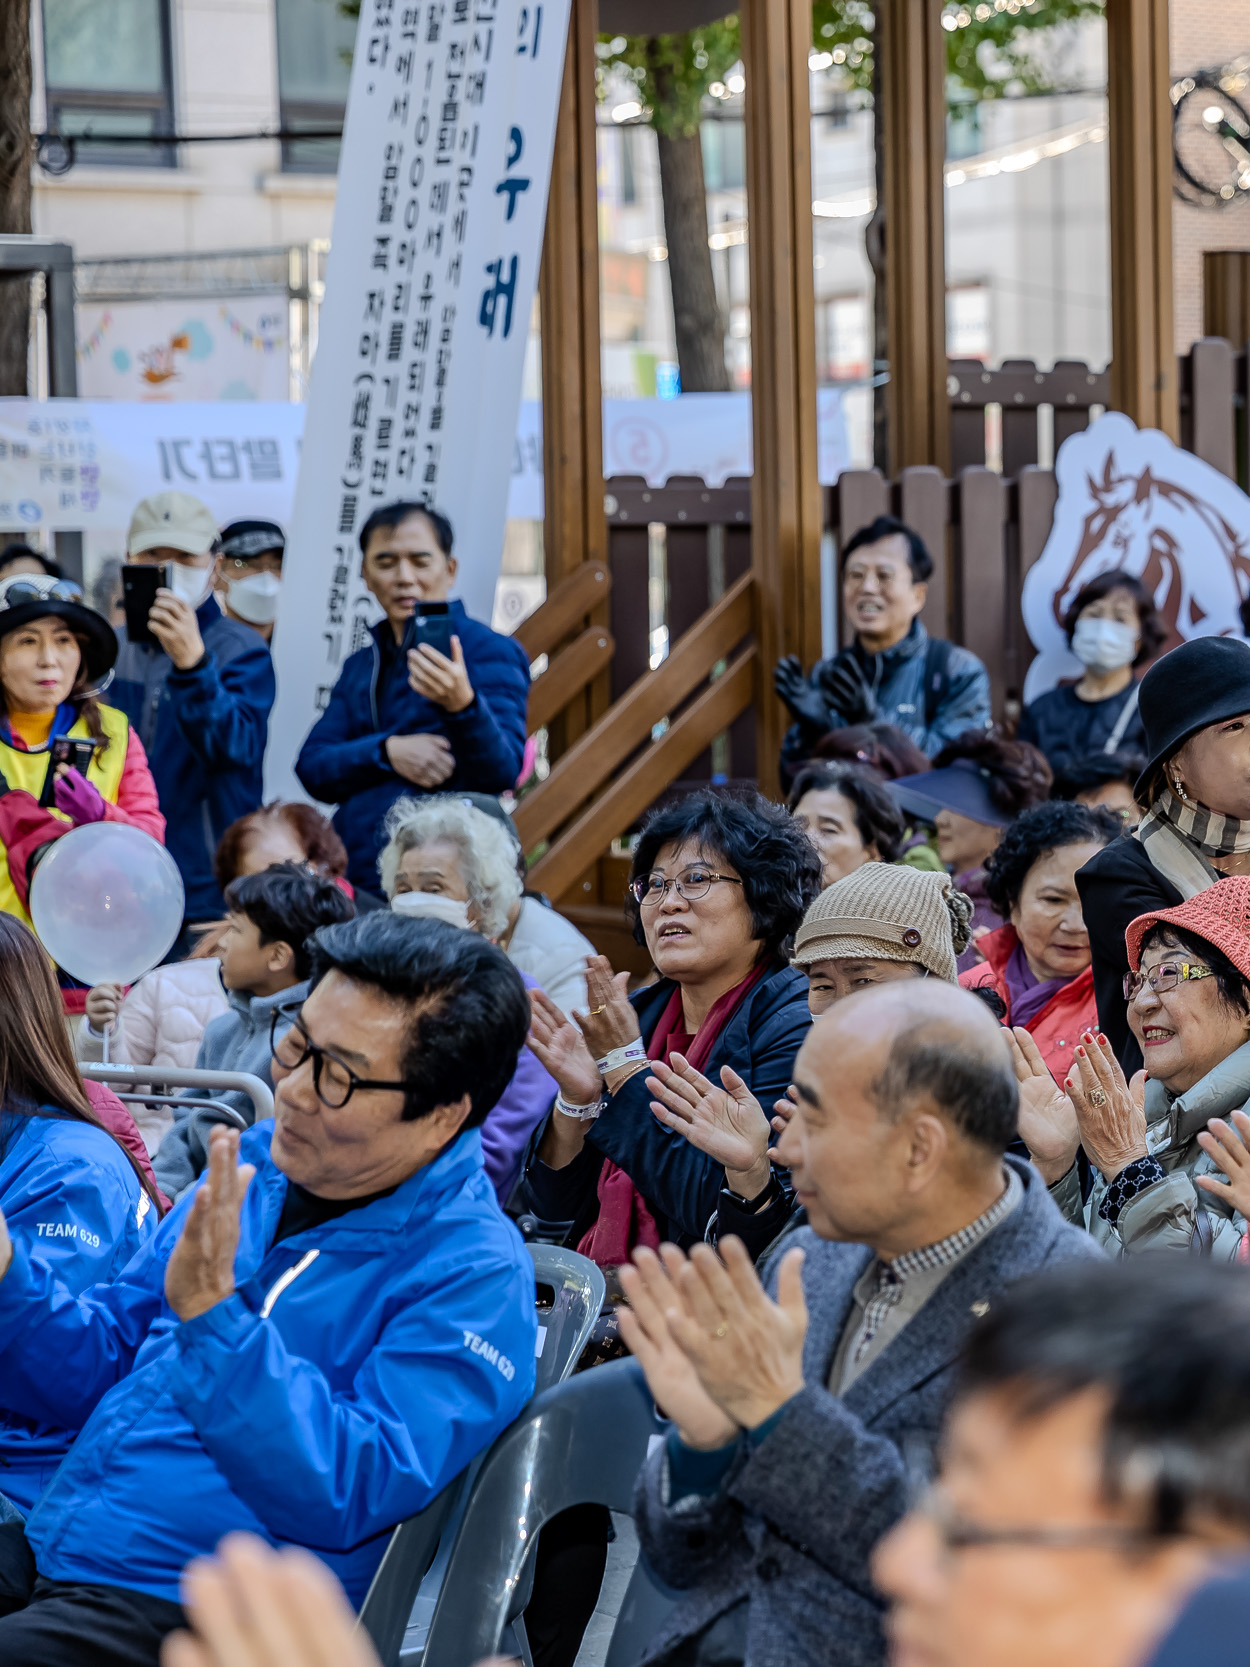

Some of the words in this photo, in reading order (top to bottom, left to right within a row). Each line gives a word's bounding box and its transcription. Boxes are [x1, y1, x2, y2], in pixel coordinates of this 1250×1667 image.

[36, 1223, 77, 1238] TEAM
[79, 1228, 100, 1249] 629
[462, 1329, 500, 1366] TEAM
[497, 1355, 516, 1382] 629
